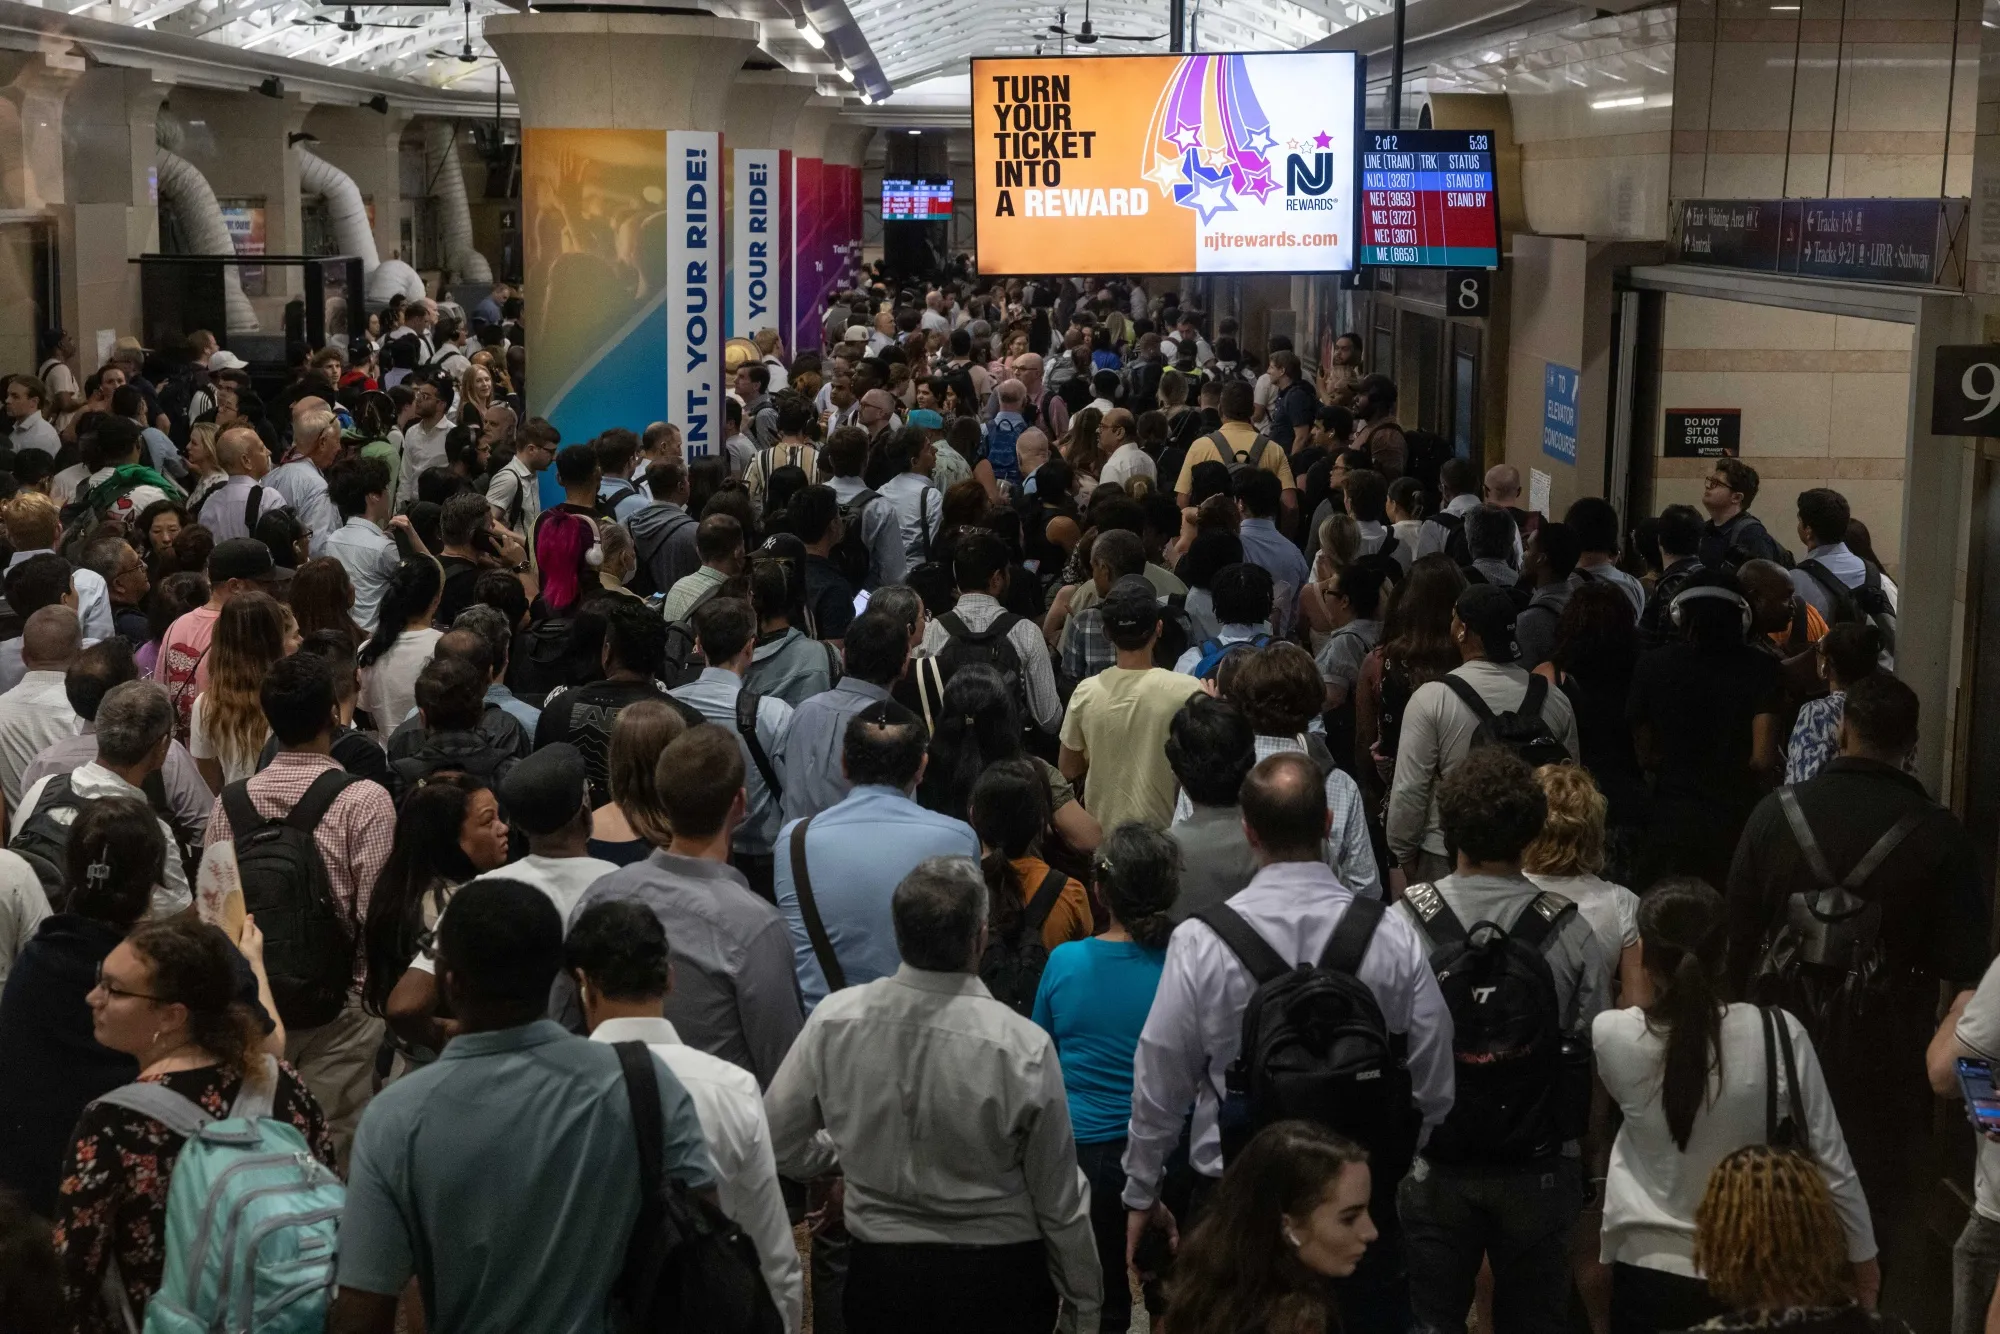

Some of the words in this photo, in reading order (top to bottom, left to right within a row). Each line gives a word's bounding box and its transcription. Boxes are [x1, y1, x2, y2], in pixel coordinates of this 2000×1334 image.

[993, 75, 1070, 103] TURN
[993, 104, 1072, 131] YOUR
[994, 131, 1096, 159] TICKET
[1375, 136, 1382, 150] 2
[1383, 136, 1392, 150] of
[1392, 136, 1398, 150] 2
[1469, 136, 1488, 150] 5:33
[1364, 155, 1382, 169] LINE
[1384, 154, 1414, 170] (TRAIN)
[1421, 155, 1437, 170] TRK
[1449, 155, 1480, 170] STATUS
[996, 160, 1060, 187] INTO
[1286, 152, 1334, 196] NJ
[1367, 174, 1386, 188] NJCL
[1388, 174, 1416, 189] (3267)
[1446, 174, 1474, 188] STAND
[1475, 174, 1485, 188] BY
[686, 148, 708, 248] RIDE!
[749, 163, 768, 232] RIDE!
[996, 190, 1015, 216] A
[1024, 188, 1148, 217] REWARD
[1370, 192, 1386, 206] NEC
[1388, 192, 1416, 208] (3953)
[1448, 192, 1474, 207] STAND
[1476, 193, 1486, 208] BY
[503, 214, 511, 227] 4
[1372, 210, 1388, 225] NEC
[1390, 210, 1416, 226] (3727)
[1693, 207, 1704, 226] Exit
[1708, 208, 1730, 232] Waiting
[1730, 209, 1744, 228] Area
[1817, 210, 1838, 232] Tracks
[1204, 231, 1338, 251] njtrewards.com
[1374, 229, 1390, 243] NEC
[1392, 229, 1418, 244] (3871)
[1690, 234, 1712, 253] Amtrak
[1376, 248, 1389, 262] ME
[1814, 241, 1837, 264] Tracks
[1870, 243, 1893, 266] LIRR
[1898, 244, 1930, 274] Subway
[749, 241, 767, 320] YOUR
[1458, 278, 1479, 310] 8
[686, 260, 708, 374] YOUR
[1558, 374, 1566, 394] TO
[1962, 362, 2000, 421] 9
[1548, 400, 1574, 426] ELEVATOR
[1544, 426, 1575, 457] CONCOURSE
[763, 536, 777, 550] NY
[1470, 986, 1497, 1004] VT
